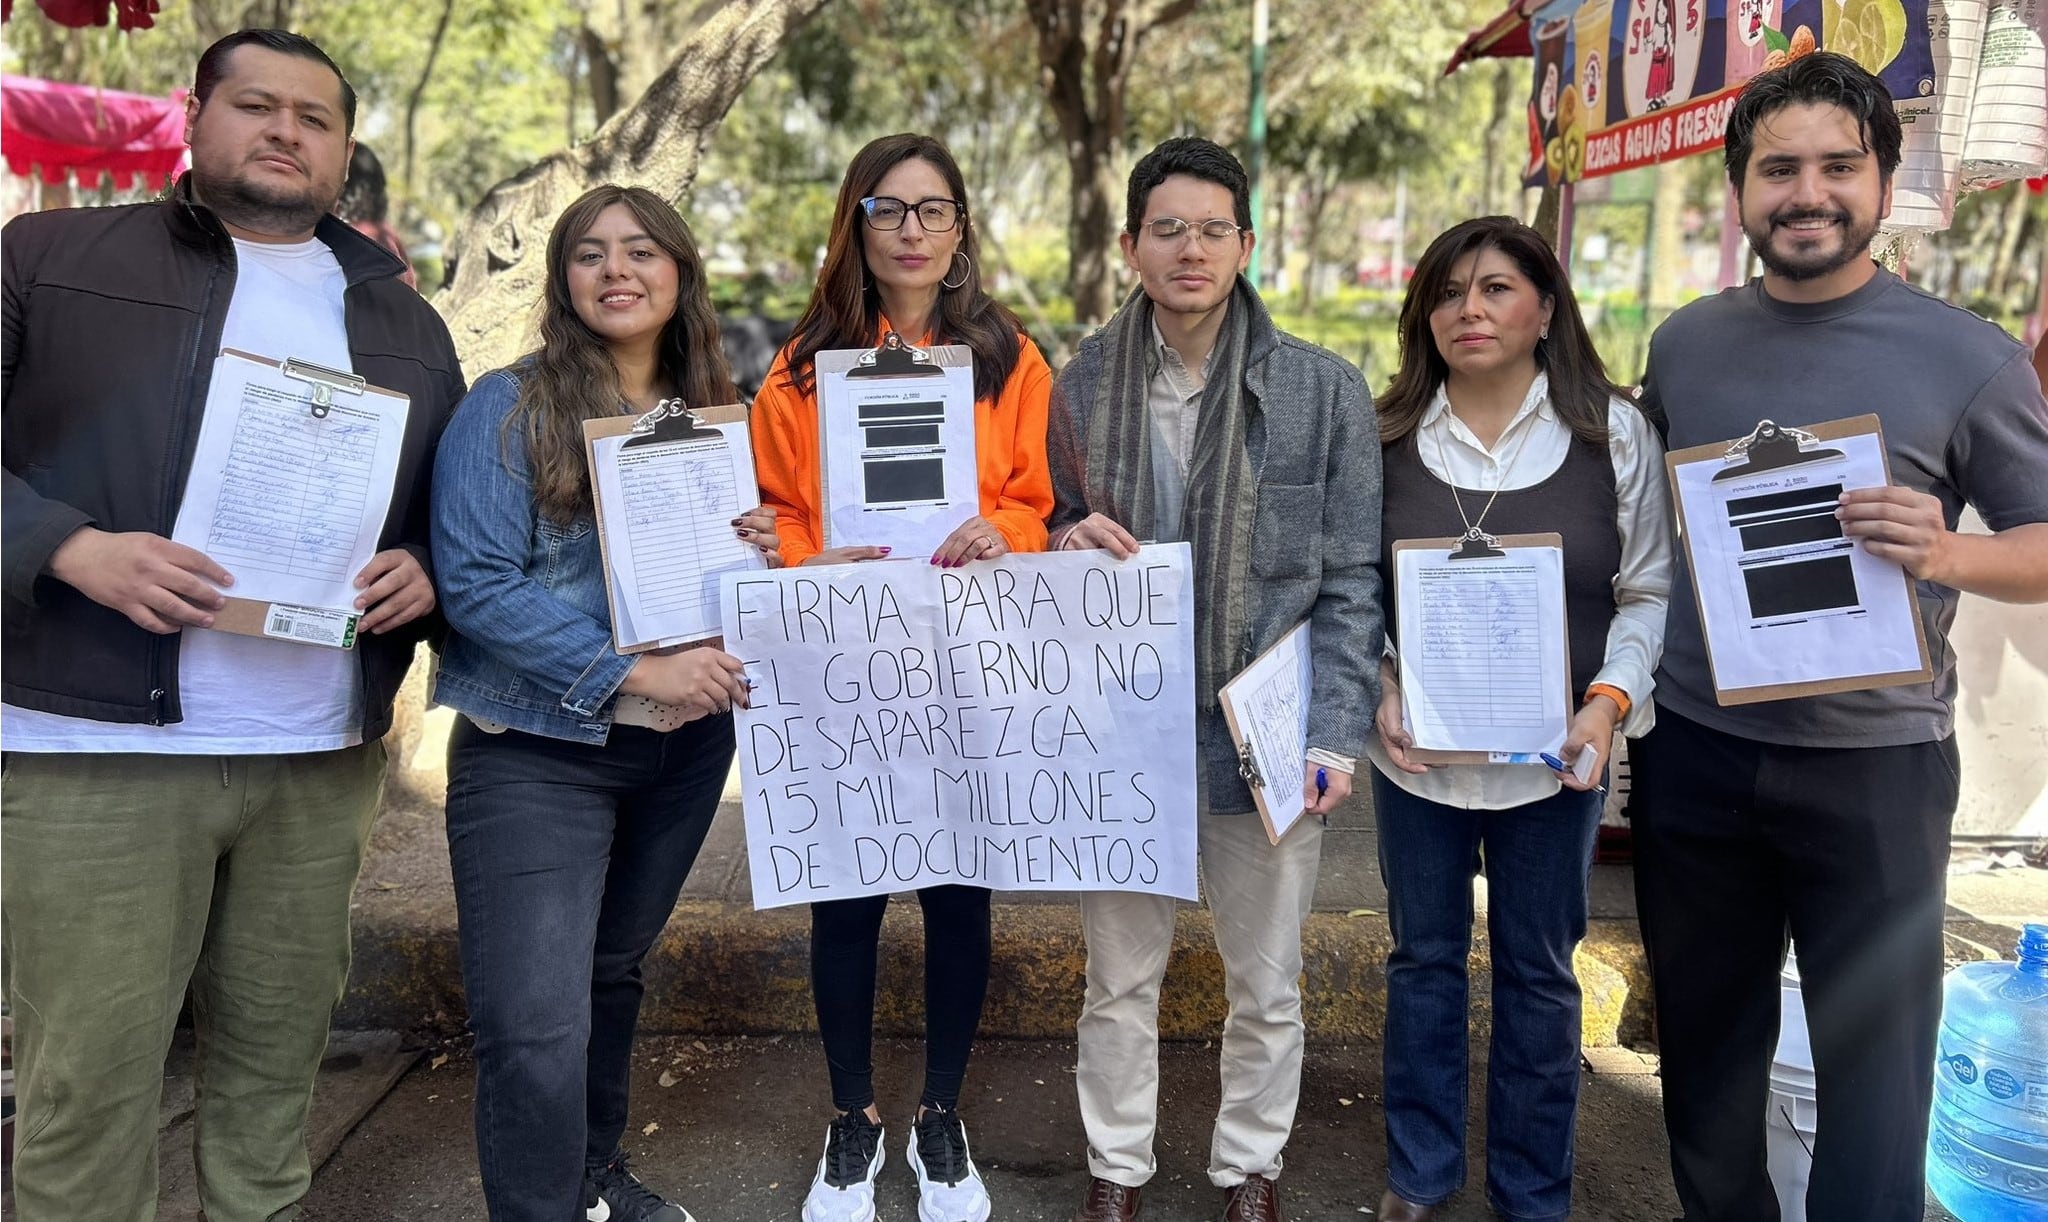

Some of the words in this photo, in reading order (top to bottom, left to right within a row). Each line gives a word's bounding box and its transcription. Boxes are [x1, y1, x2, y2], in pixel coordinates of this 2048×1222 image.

[1585, 131, 1621, 170] RICAS
[1624, 116, 1673, 162] AGUAS
[735, 579, 911, 644] FIRMA
[941, 568, 1066, 637] PARA
[1082, 565, 1177, 631] QUE
[741, 658, 800, 710] EL
[824, 638, 1071, 703] GOBIERNO
[1095, 642, 1164, 700] NO
[750, 704, 1098, 776] DESAPAREZCA
[758, 781, 818, 835] 15
[836, 774, 912, 827] MIL
[933, 768, 1156, 826] MILLONES
[770, 843, 829, 893] DE
[854, 829, 1159, 886] DOCUMENTOS
[1952, 1058, 1975, 1080] ciel
